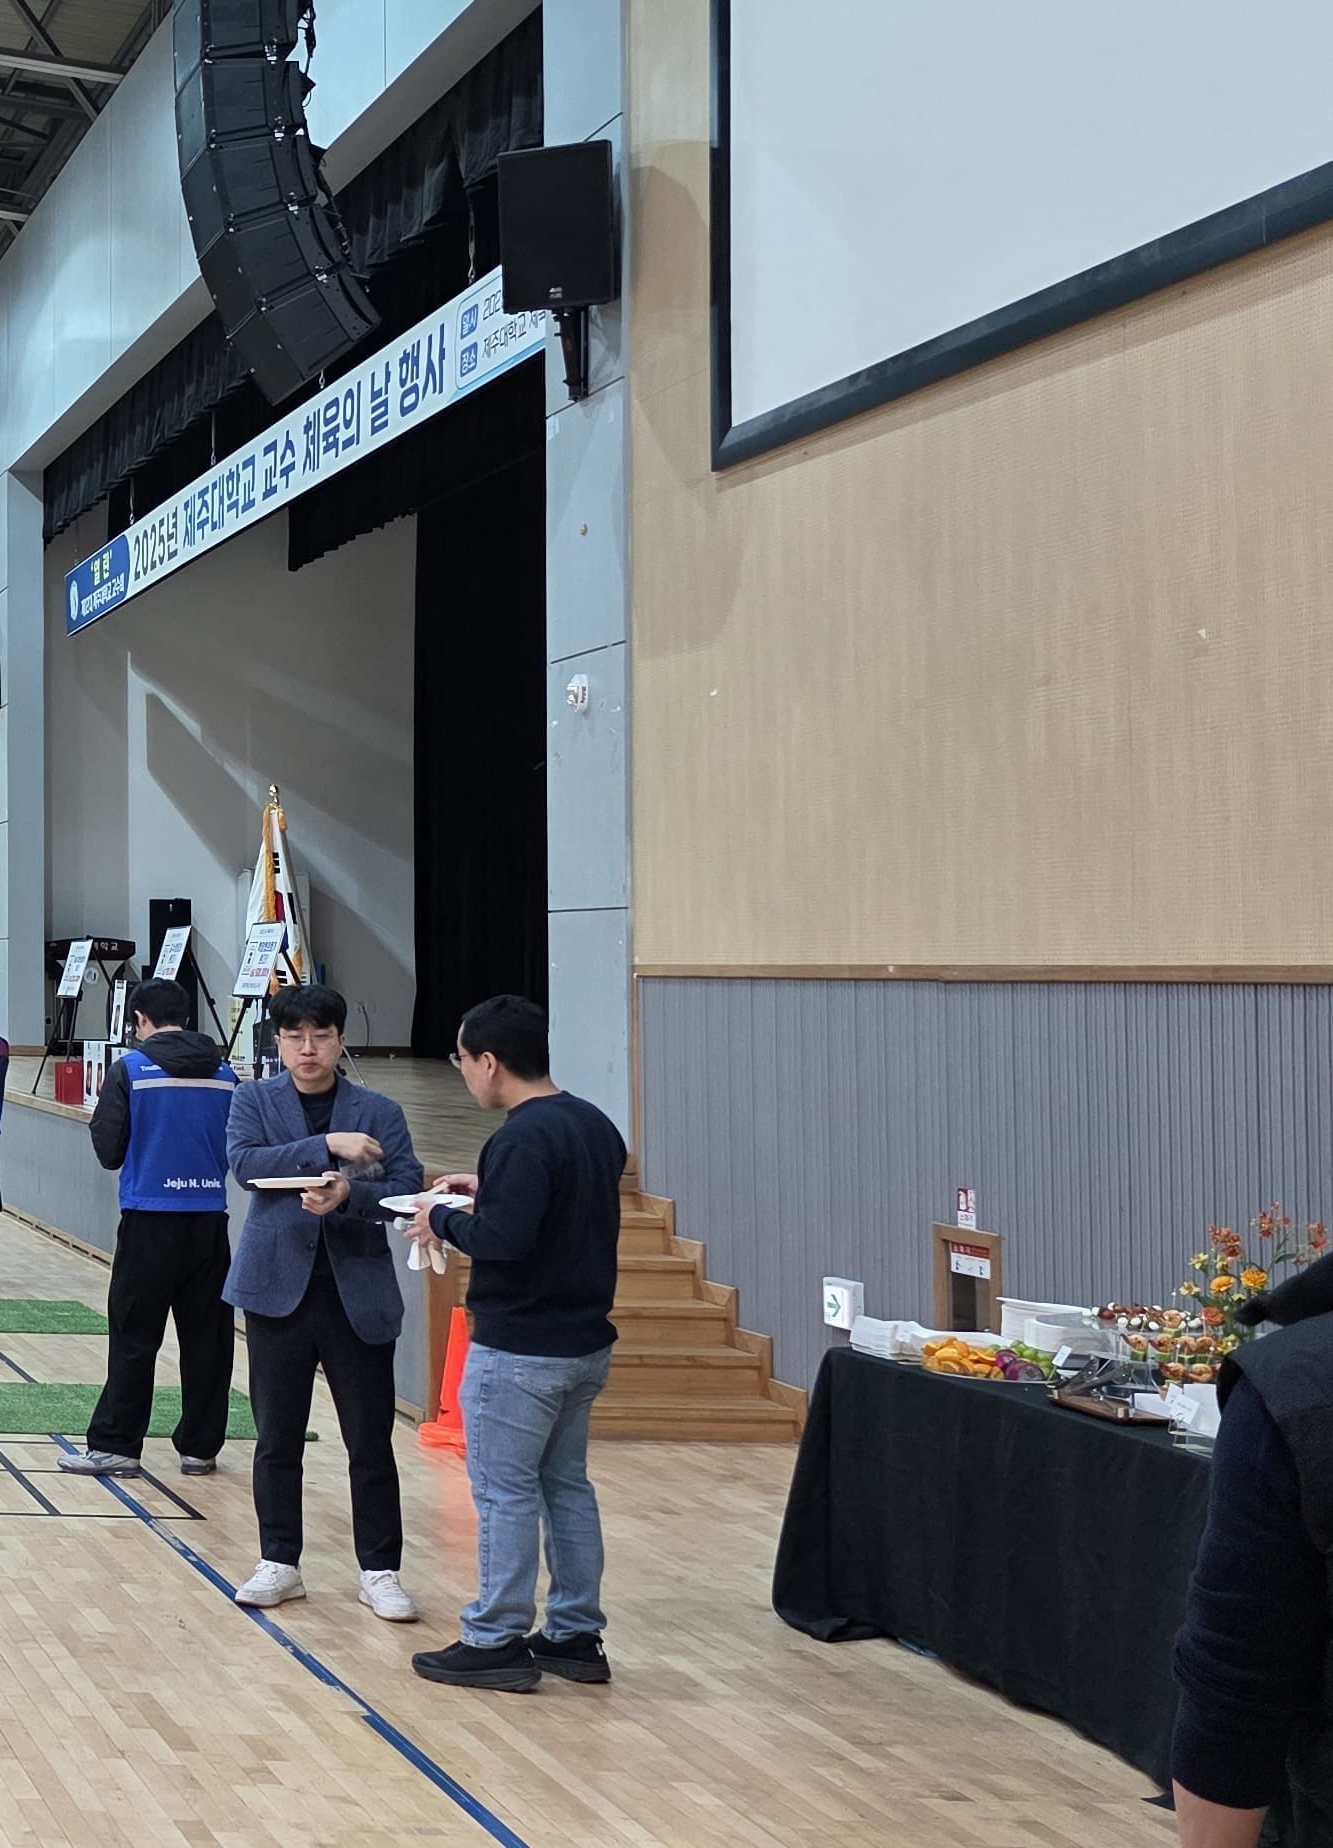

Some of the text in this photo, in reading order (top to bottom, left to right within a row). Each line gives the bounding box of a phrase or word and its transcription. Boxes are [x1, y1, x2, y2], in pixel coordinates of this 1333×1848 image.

[461, 352, 477, 373] 장소
[482, 314, 527, 358] 제주대학교
[133, 323, 446, 582] 2025년 제주대학교 교수 체육의 날 행사
[163, 1177, 188, 1191] Jeju
[188, 1179, 200, 1188] N.
